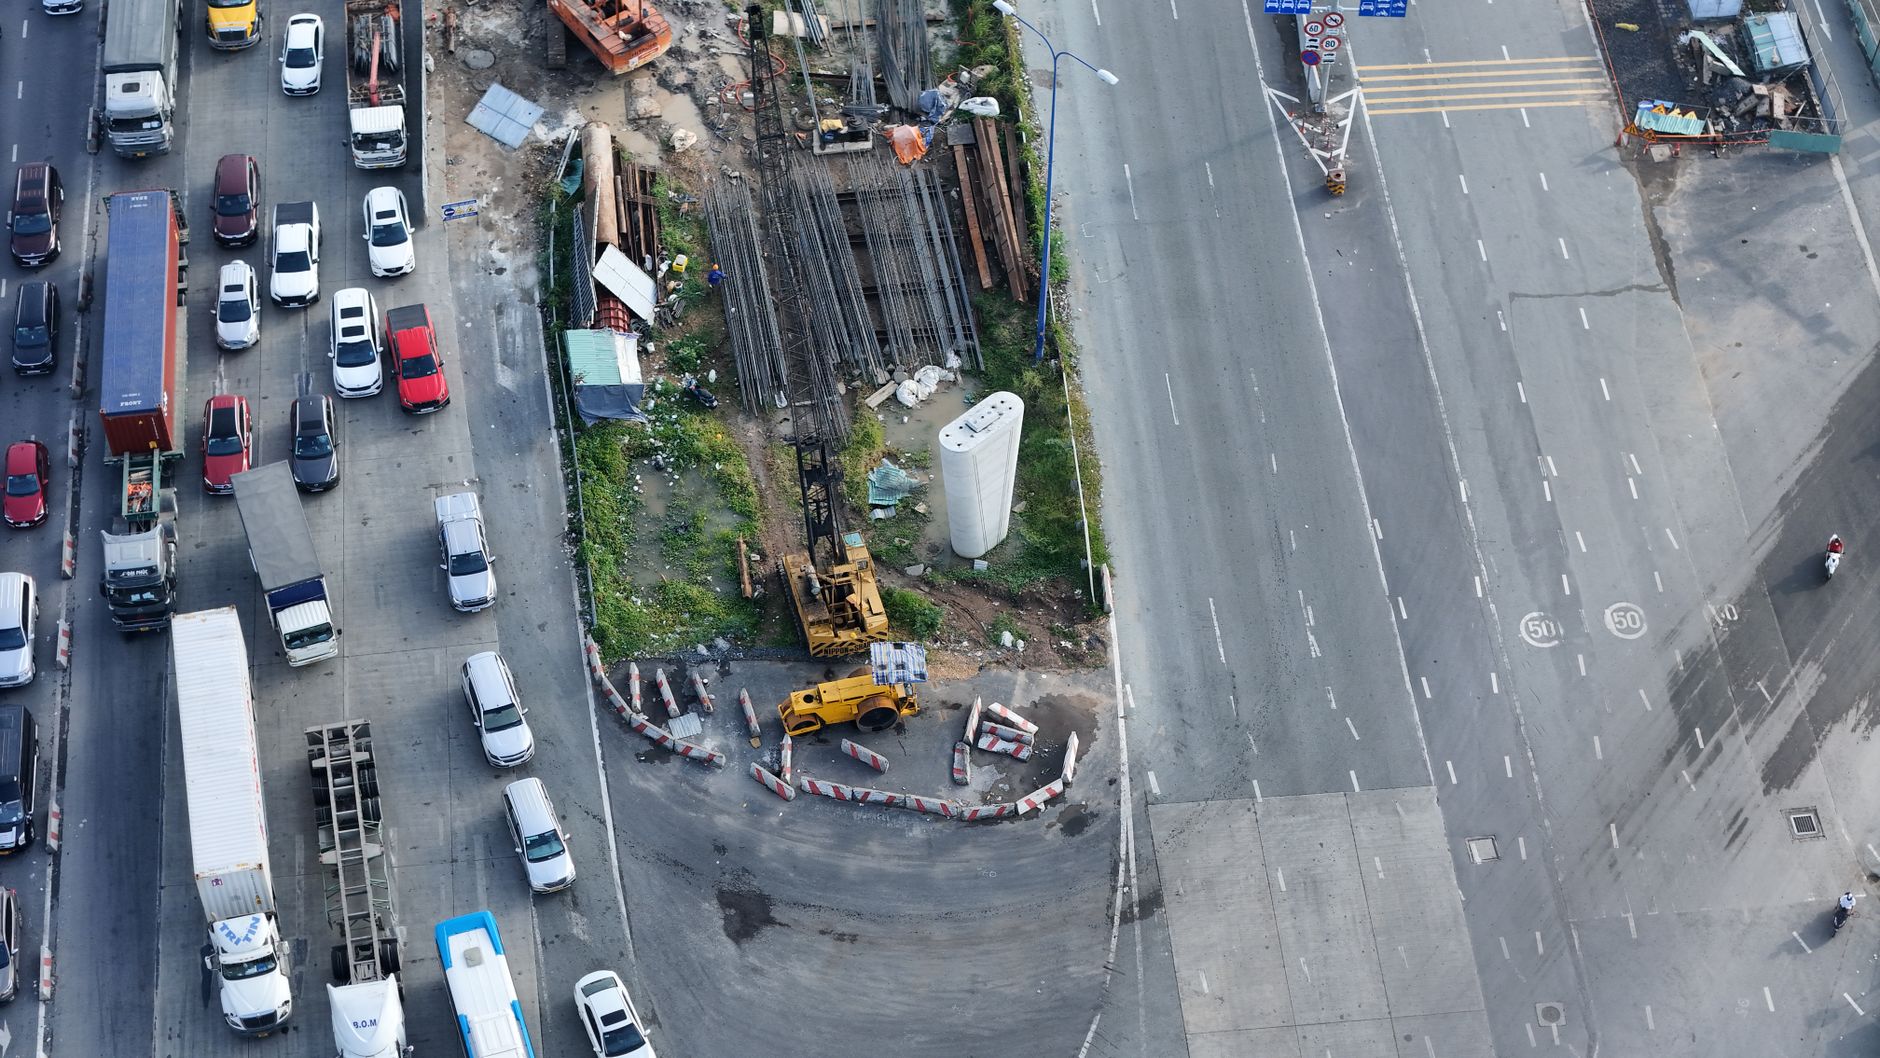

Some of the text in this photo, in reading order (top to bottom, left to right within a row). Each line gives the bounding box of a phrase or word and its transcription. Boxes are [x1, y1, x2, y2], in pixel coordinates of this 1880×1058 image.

[1308, 25, 1319, 33] 60
[1325, 40, 1336, 48] 80
[1613, 611, 1641, 629] 50
[1527, 620, 1556, 639] 50
[823, 647, 849, 655] NIPPON
[352, 1019, 377, 1029] B.O.M
